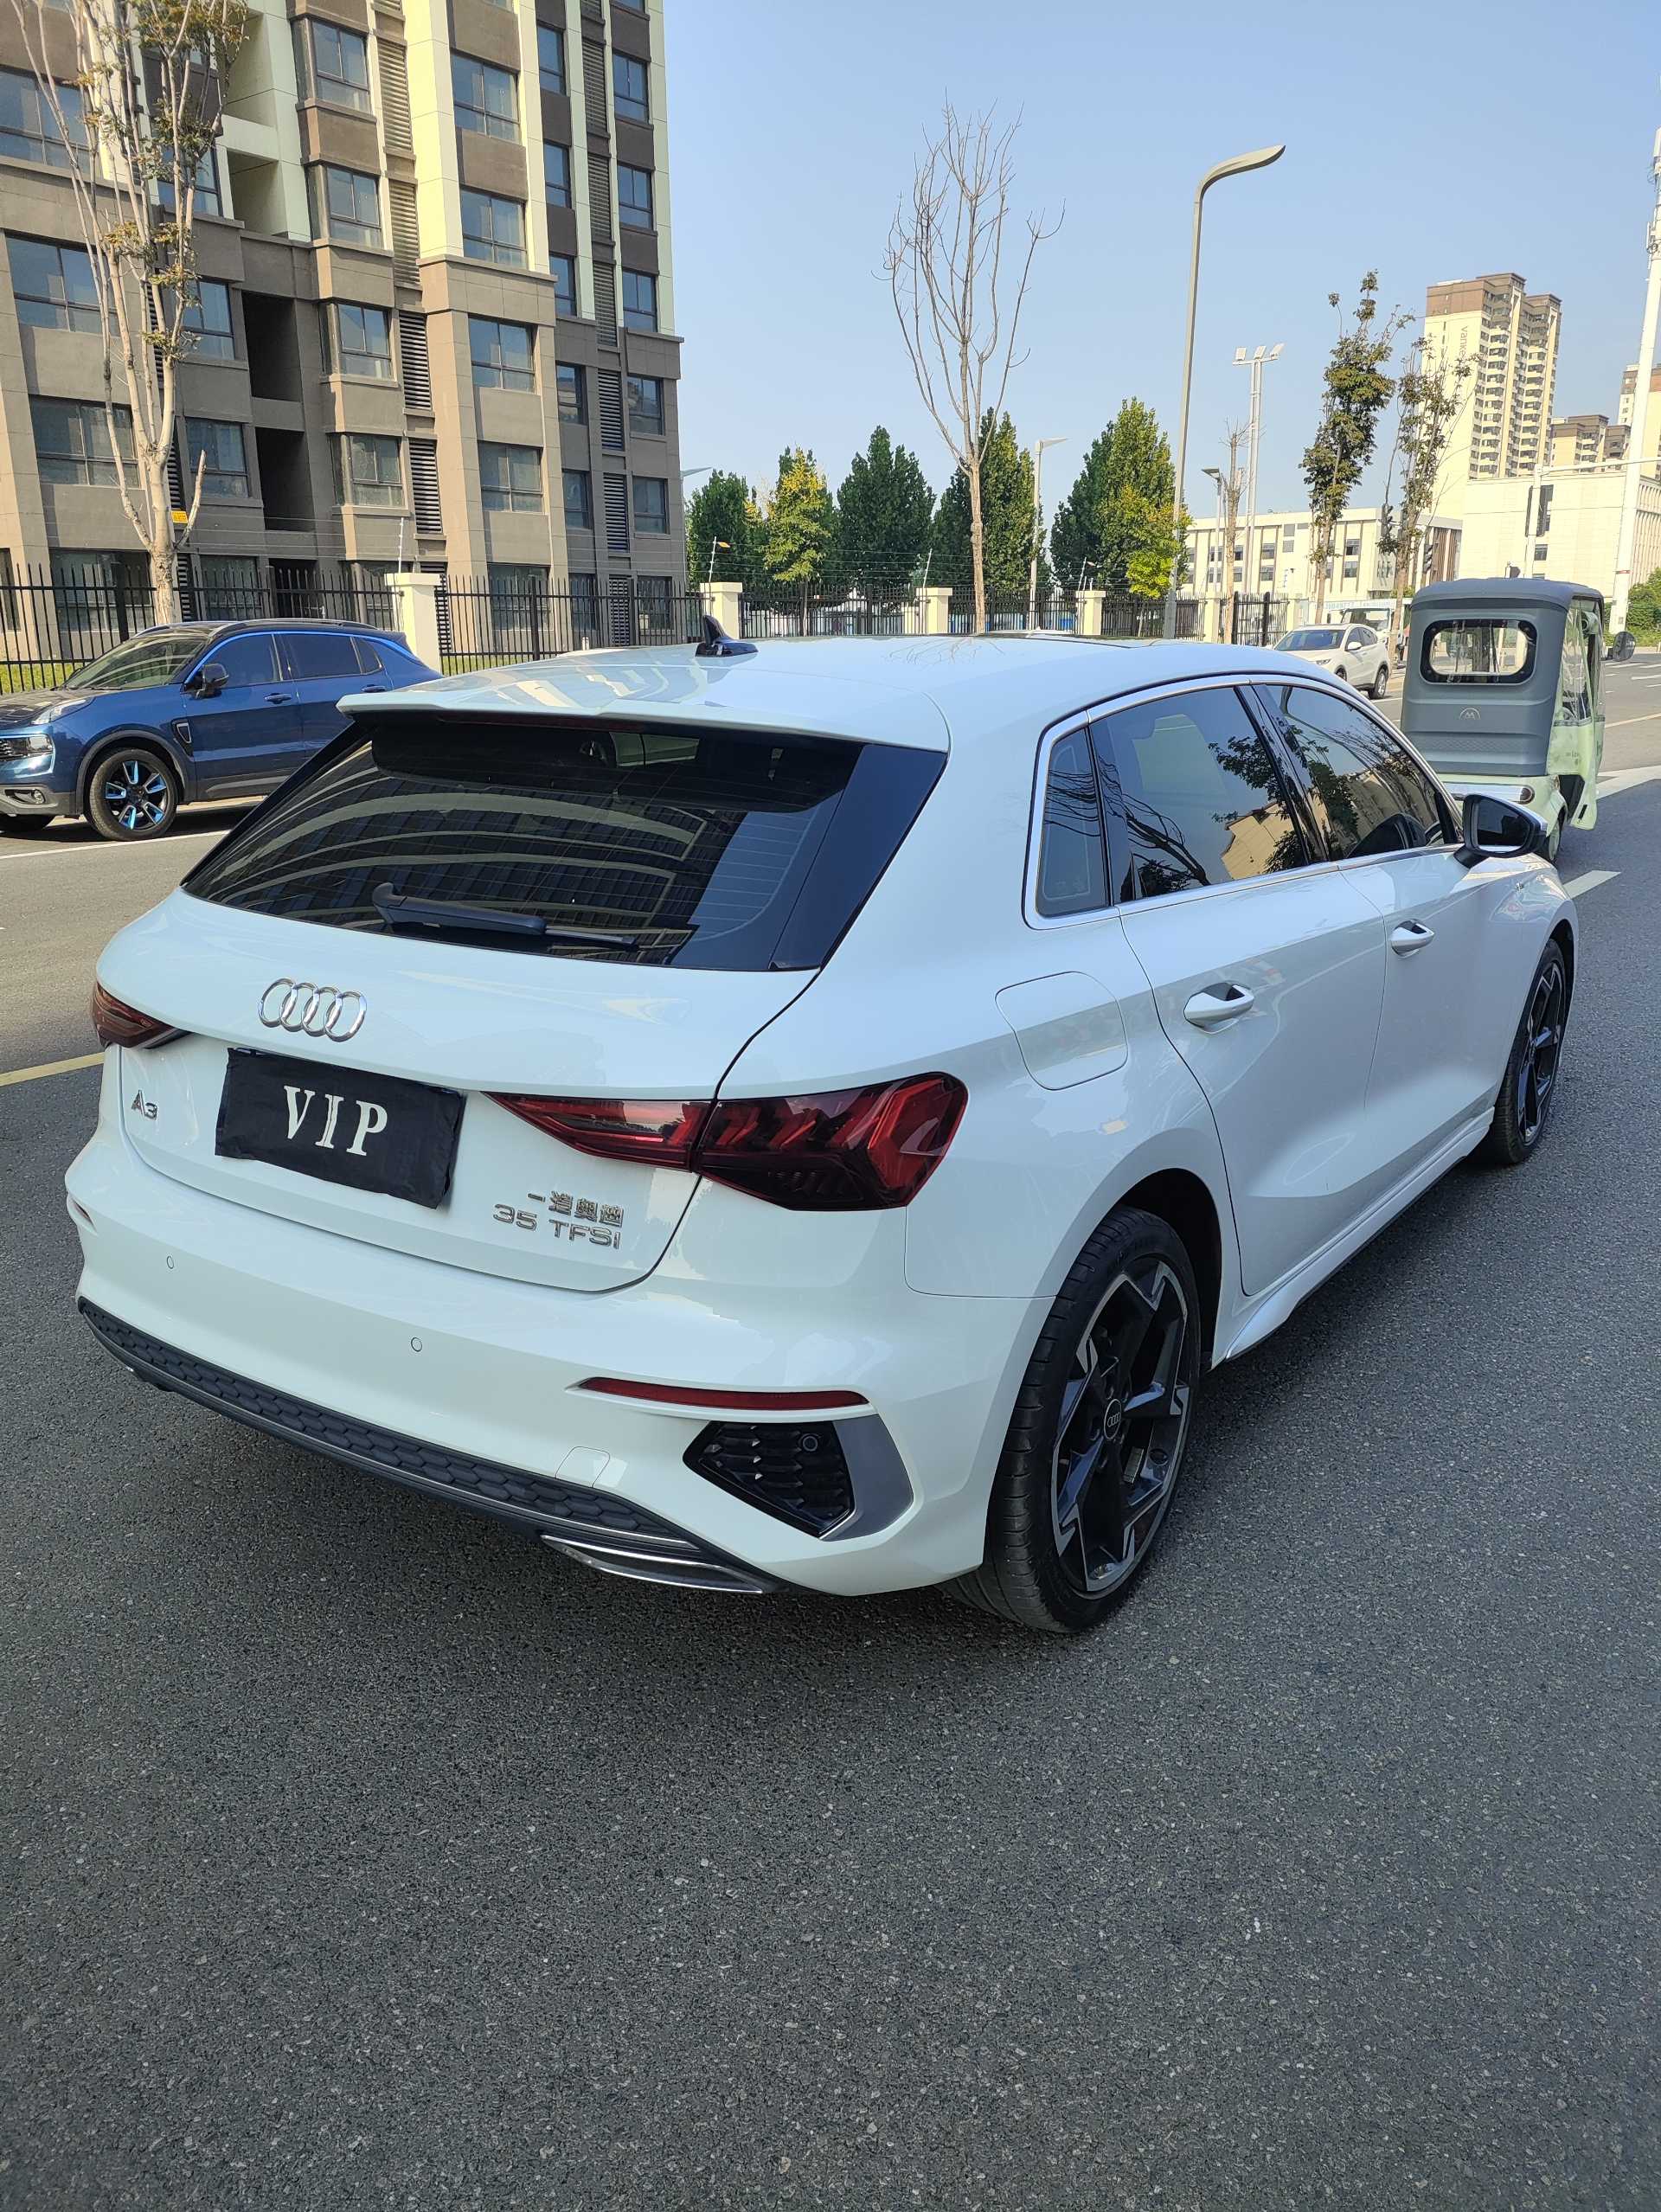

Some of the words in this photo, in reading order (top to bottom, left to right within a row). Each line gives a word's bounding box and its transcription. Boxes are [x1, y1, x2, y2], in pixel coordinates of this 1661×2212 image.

[131, 1089, 158, 1121] A3
[284, 1085, 388, 1157] VIP
[492, 1203, 538, 1232] 35
[548, 1219, 621, 1250] TFSI
